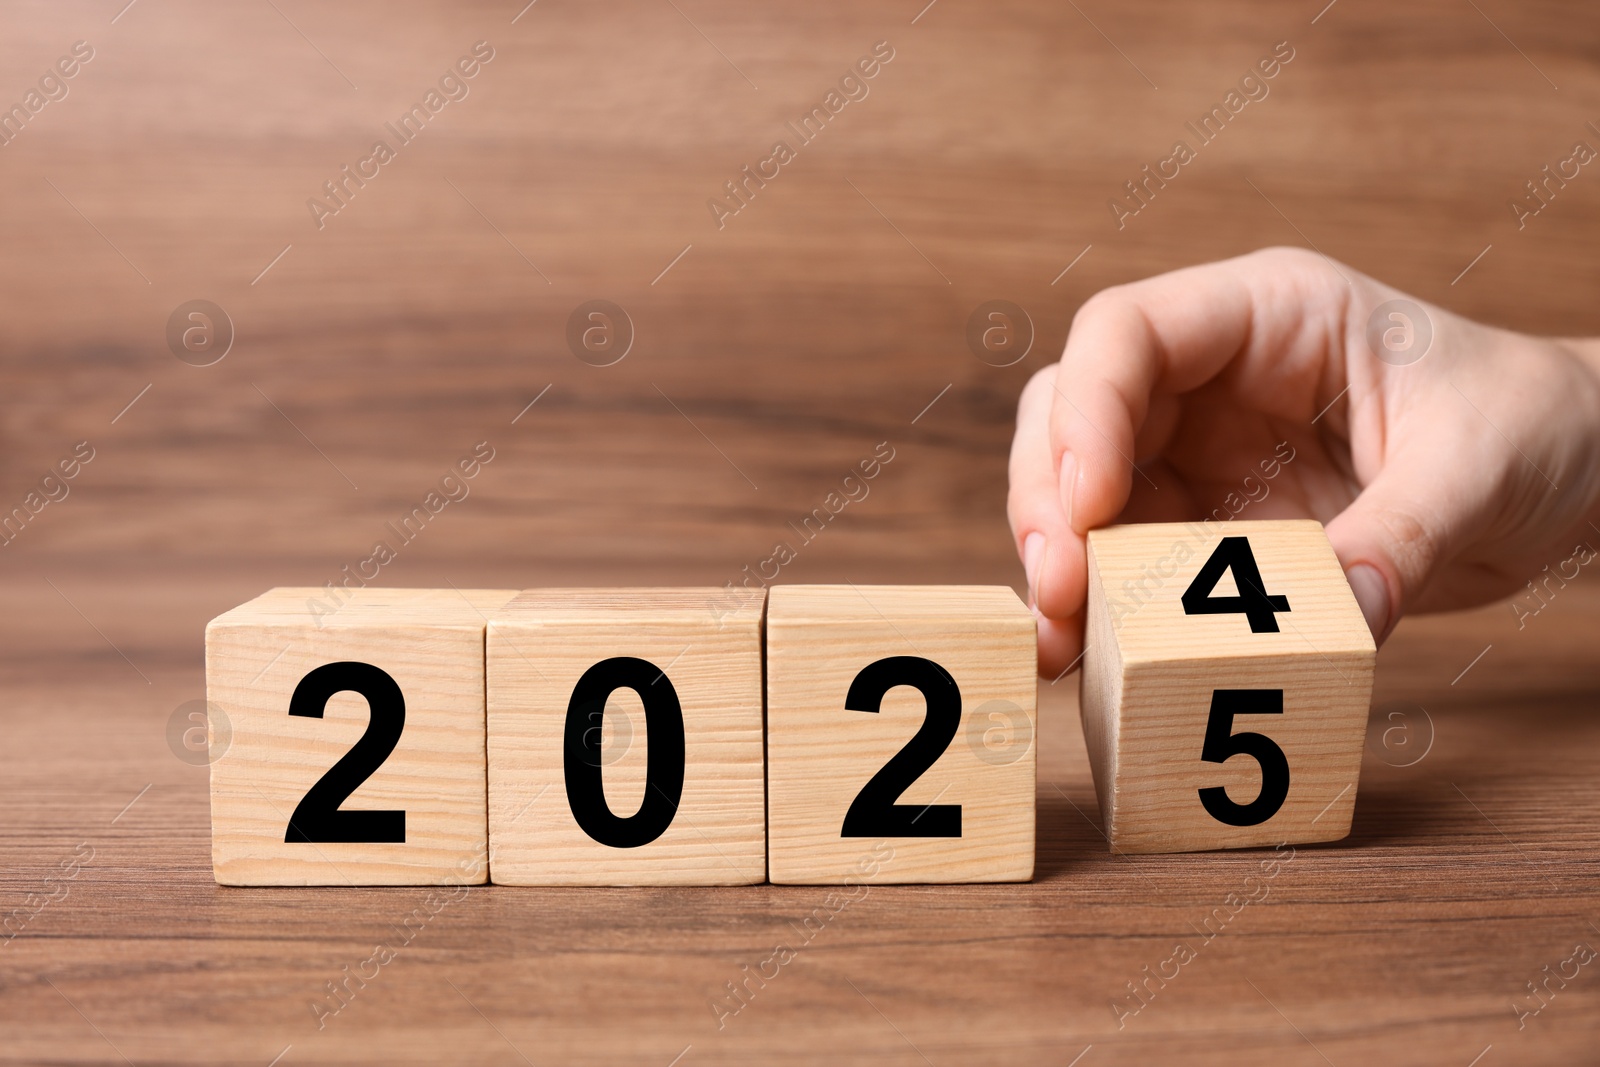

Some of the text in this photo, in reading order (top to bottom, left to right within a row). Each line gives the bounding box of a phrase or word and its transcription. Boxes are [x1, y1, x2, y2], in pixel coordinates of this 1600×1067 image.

[1181, 537, 1291, 633] 4
[285, 656, 1290, 848] 2 0 2 5
